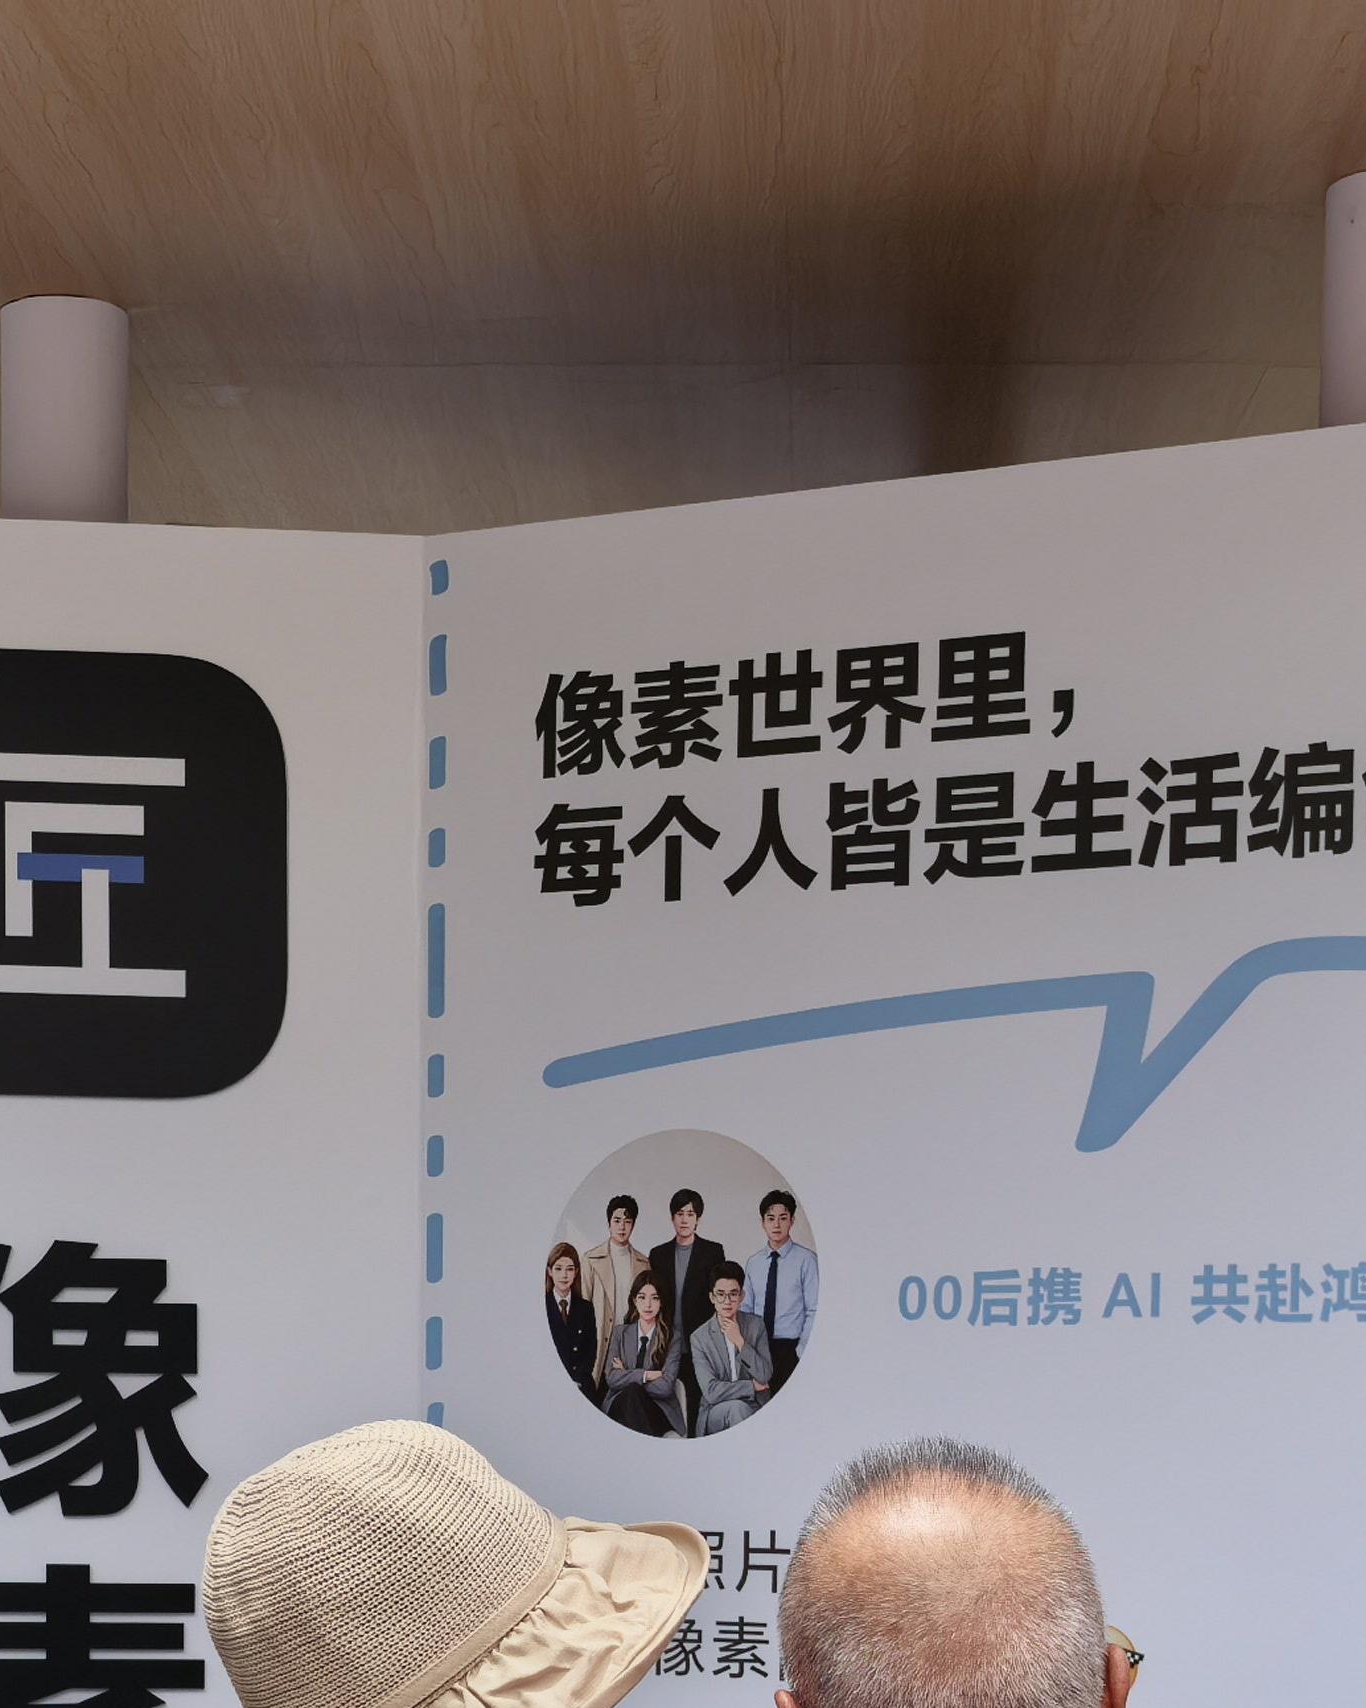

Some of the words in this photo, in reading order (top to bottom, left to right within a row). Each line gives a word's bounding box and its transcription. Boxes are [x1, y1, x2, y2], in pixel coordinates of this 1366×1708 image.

[534, 630, 1078, 778] 像素世界里，
[898, 1266, 1084, 1329] 00后携
[1101, 1272, 1163, 1319] AI
[654, 1616, 786, 1682] 像素
